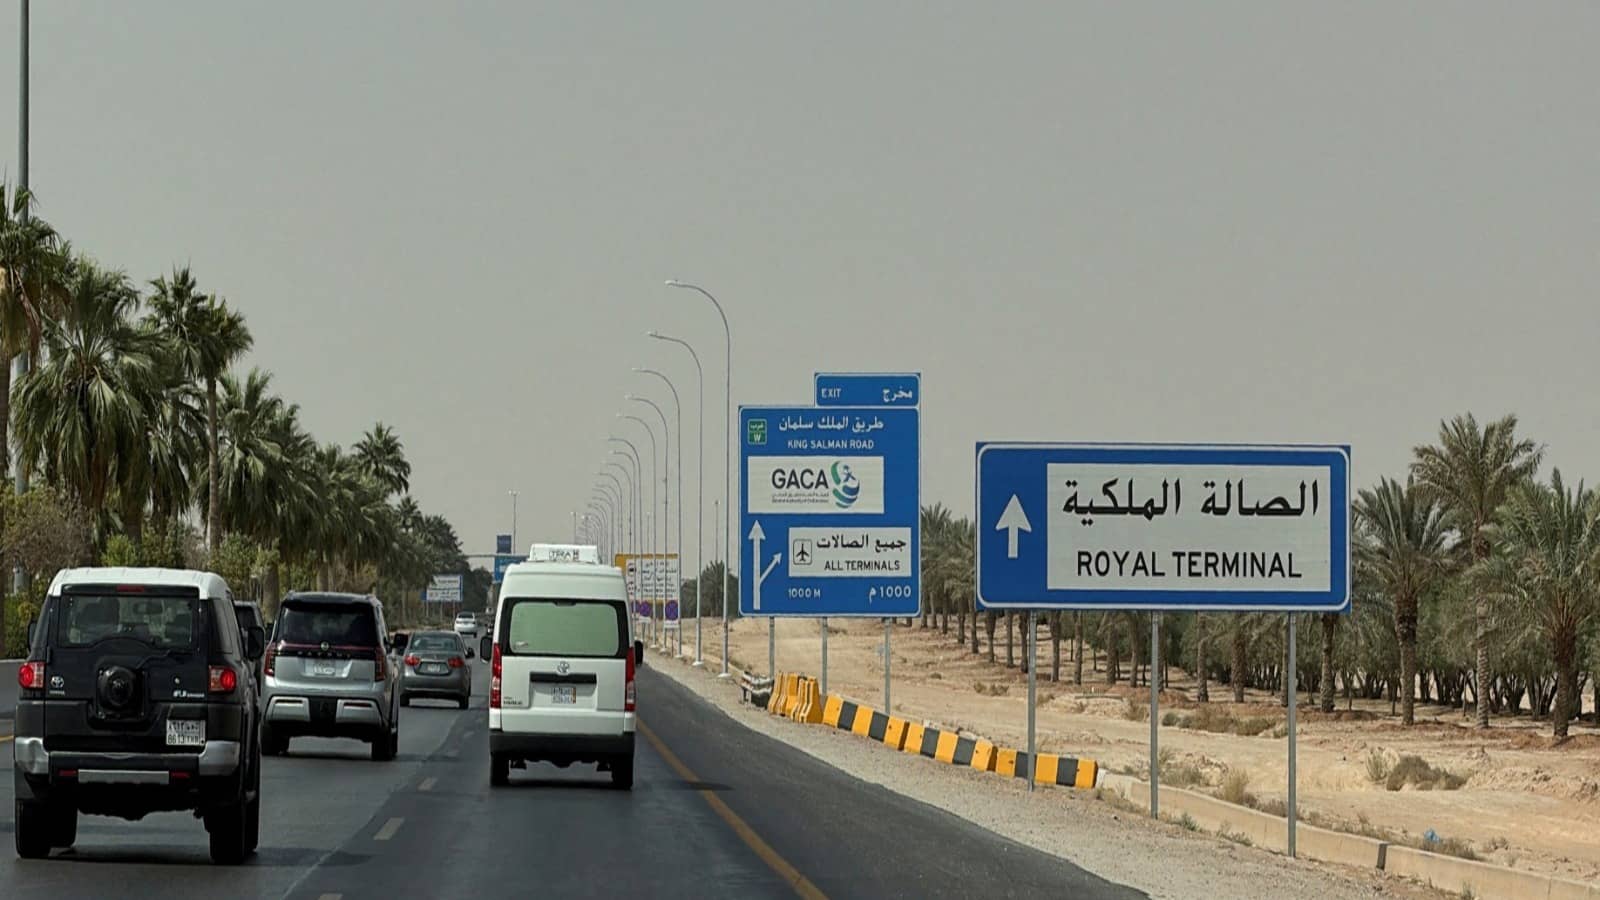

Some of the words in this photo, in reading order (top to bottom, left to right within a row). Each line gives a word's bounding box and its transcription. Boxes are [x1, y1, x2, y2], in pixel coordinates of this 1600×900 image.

[821, 387, 842, 399] EXIT
[882, 385, 913, 403] مخرج
[778, 415, 814, 431] سلمان
[817, 415, 849, 430] الملك
[851, 415, 884, 433] طريق
[753, 432, 761, 443] W
[787, 439, 808, 449] KING
[810, 439, 848, 449] SALMAN
[849, 439, 874, 449] ROAD
[771, 468, 829, 490] GACA
[1062, 477, 1181, 527] الملكية
[1200, 478, 1319, 518] الصالة
[816, 533, 869, 549] الصالات
[874, 536, 907, 554] جميع
[824, 560, 843, 571] ALL
[845, 560, 901, 571] TERMINALS
[1077, 550, 1165, 577] ROYAL
[1172, 551, 1302, 578] TERMINAL
[788, 587, 812, 598] 1000
[813, 588, 821, 598] M
[868, 586, 877, 605] م
[879, 585, 912, 598] 1000
